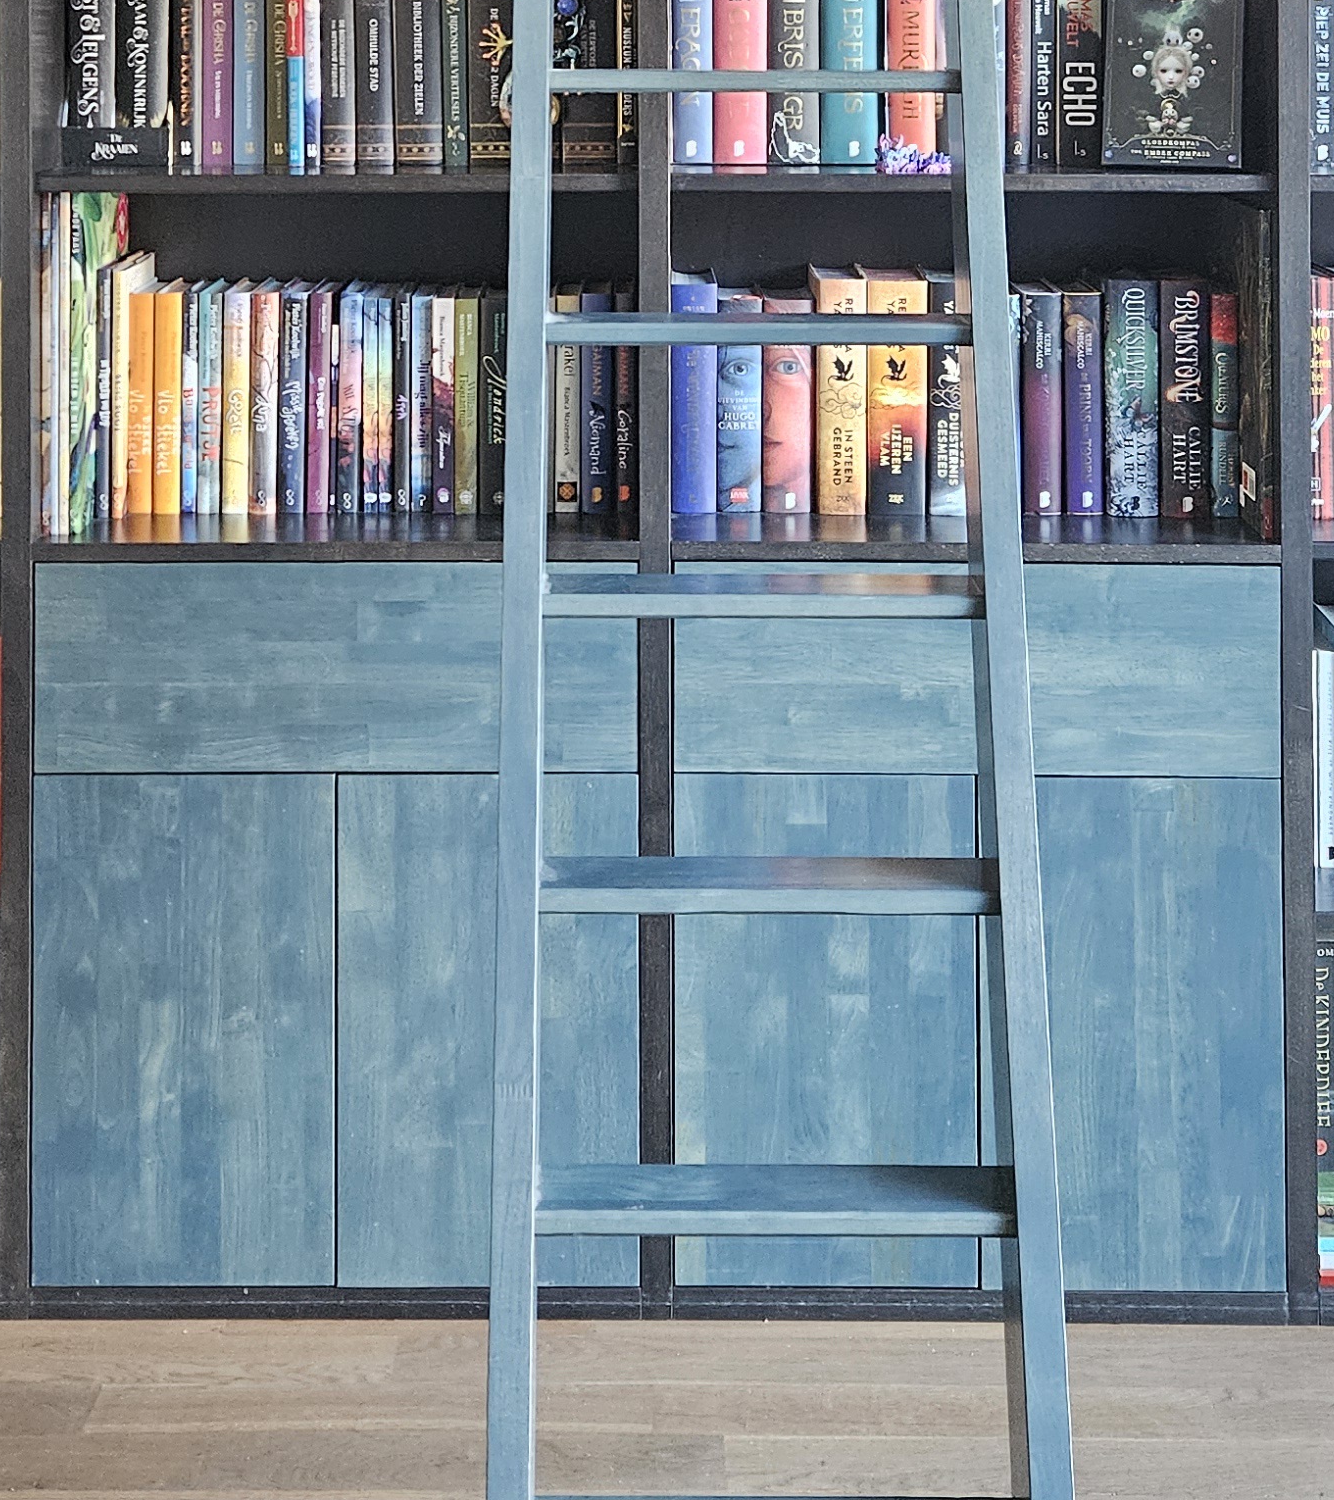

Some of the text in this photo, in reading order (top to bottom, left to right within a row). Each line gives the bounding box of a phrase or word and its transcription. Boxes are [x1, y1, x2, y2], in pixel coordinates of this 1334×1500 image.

[131, 26, 149, 39] &
[70, 34, 100, 116] LEUGENS
[127, 42, 151, 128] KONINKRIJK
[1036, 41, 1053, 136] Harten Sara
[1063, 62, 1096, 127] ECHO
[199, 386, 221, 462] PRUTJE
[1122, 287, 1150, 491] QUICKSILVER CALLIE
[1165, 290, 1202, 491] BRIMSTONE CALLIE
[586, 402, 607, 475] Niemand
[613, 408, 632, 469] Coraline
[1171, 433, 1186, 482] HART
